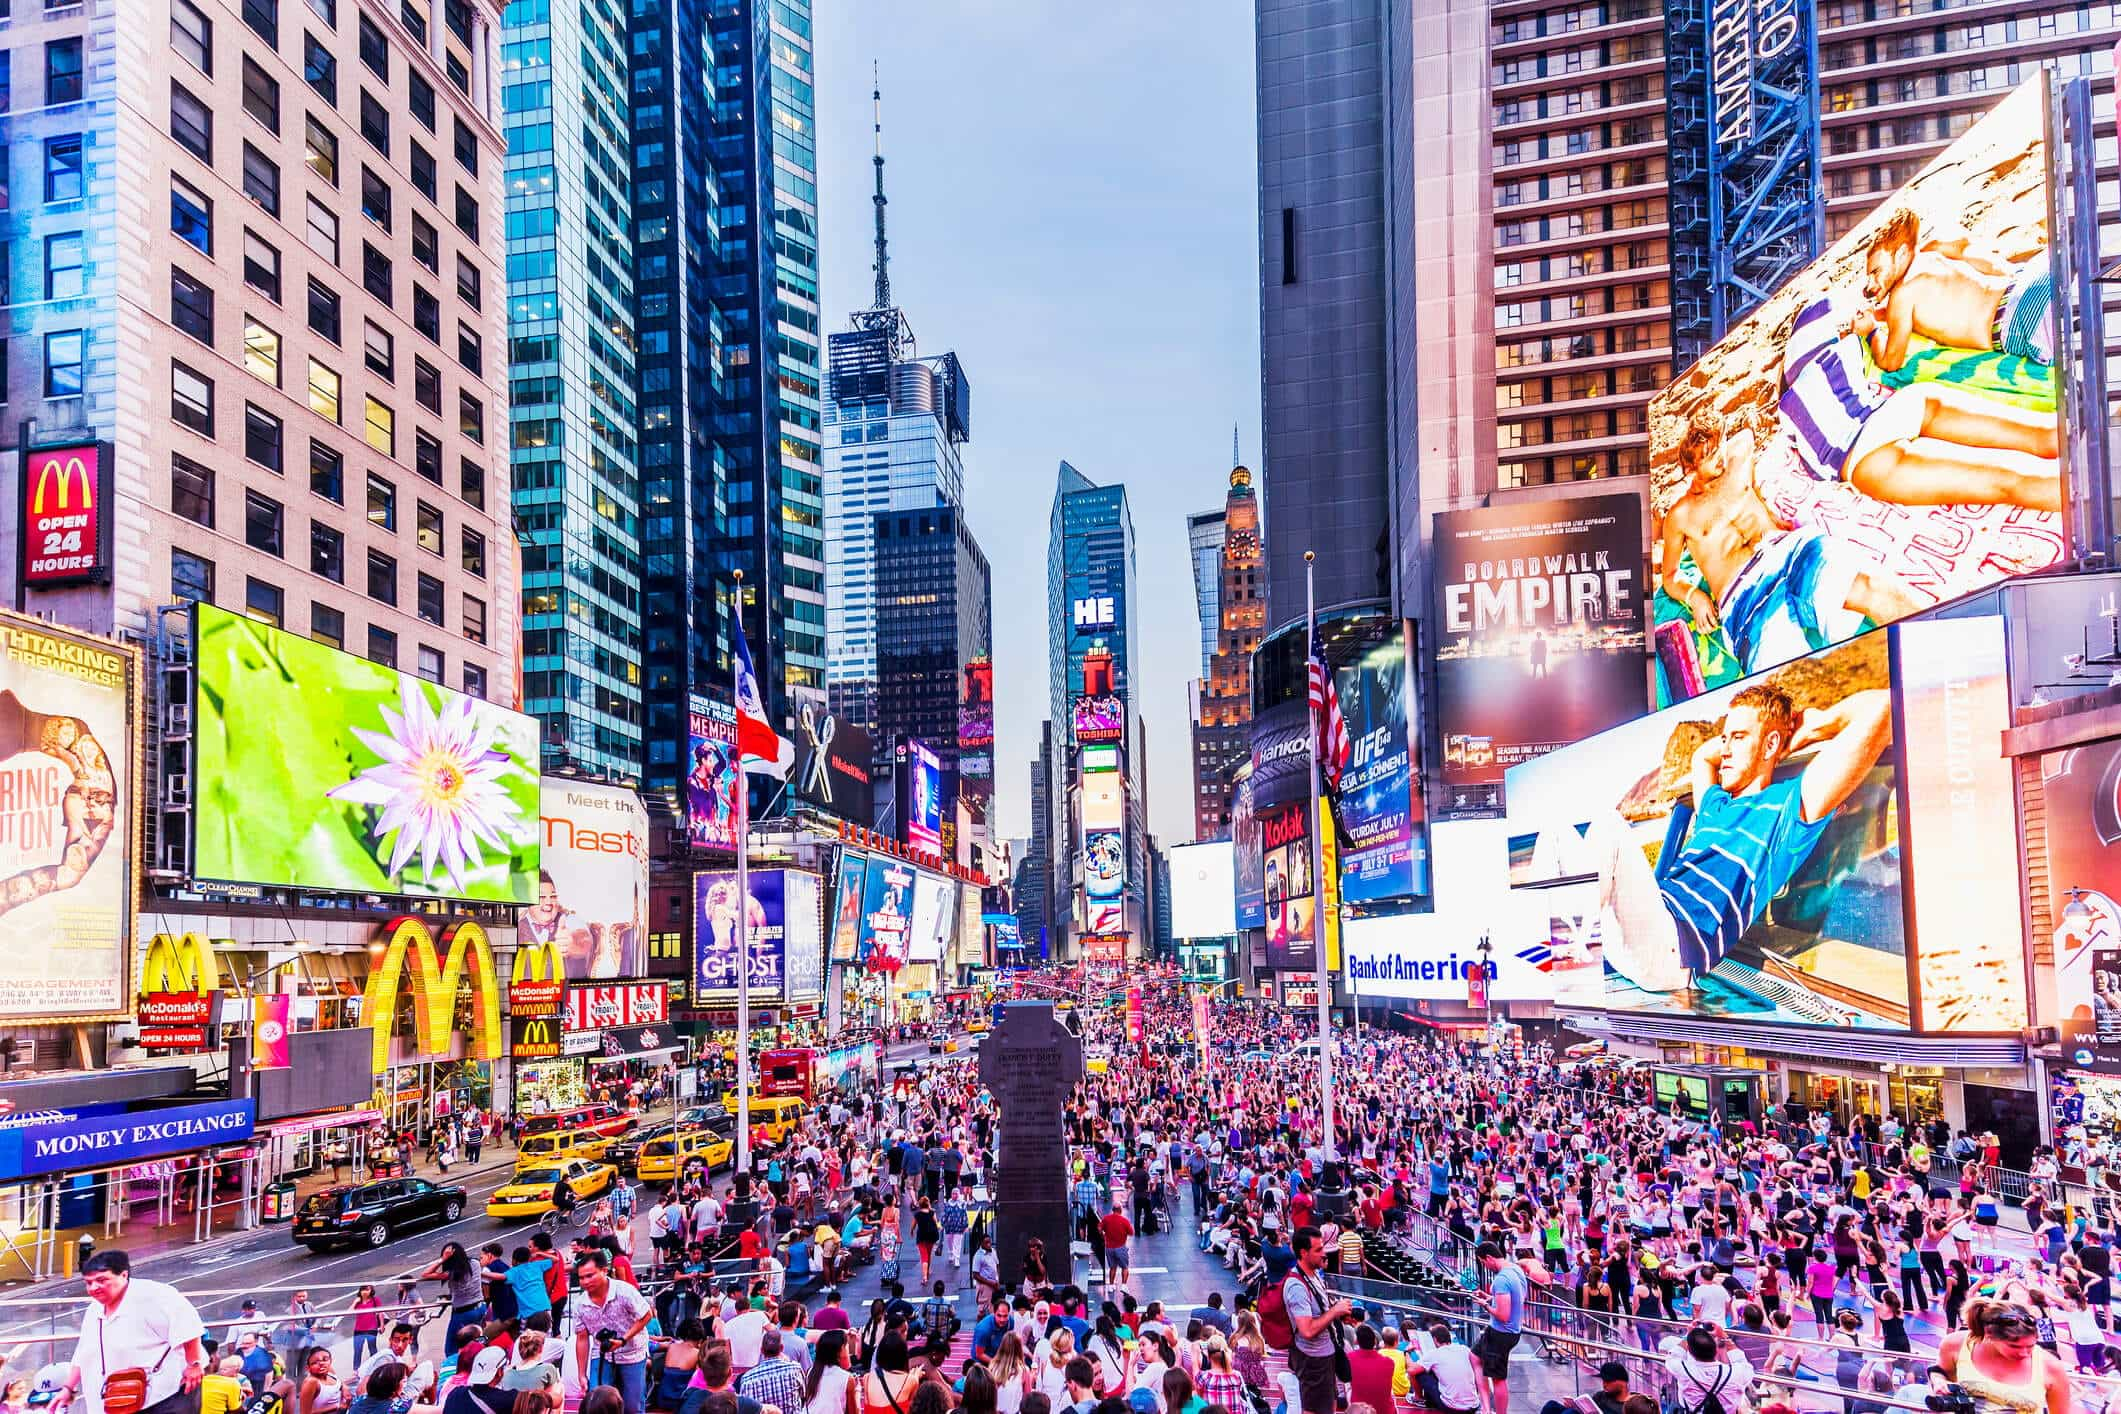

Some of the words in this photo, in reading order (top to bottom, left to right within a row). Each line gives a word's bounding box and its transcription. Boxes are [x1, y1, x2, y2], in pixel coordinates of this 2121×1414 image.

[38, 514, 88, 531] OPEN
[43, 531, 82, 555] 24
[31, 555, 93, 572] HOURS
[1464, 550, 1610, 582] BOARDWALK
[1445, 569, 1634, 633] EMPIRE
[690, 714, 738, 745] MEMPHI
[1077, 728, 1121, 739] TOSHIBA
[1354, 726, 1386, 768] UFC
[567, 792, 610, 810] Meet
[19, 806, 53, 852] ON
[1265, 806, 1304, 848] Kodak
[1348, 821, 1380, 841] ATURDAY,
[1380, 813, 1400, 831] JULY
[1399, 812, 1405, 825] 7
[1349, 954, 1379, 979] Bank
[1379, 953, 1393, 979] of
[511, 987, 561, 996] McDonald's
[140, 1001, 207, 1014] McDonald's
[149, 1014, 196, 1022] Restaurant
[140, 1035, 162, 1043] OPEN
[162, 1034, 173, 1042] 24
[174, 1034, 201, 1042] HOURS
[34, 1128, 127, 1158] MONEY
[132, 1111, 247, 1142] EXCHANGE
